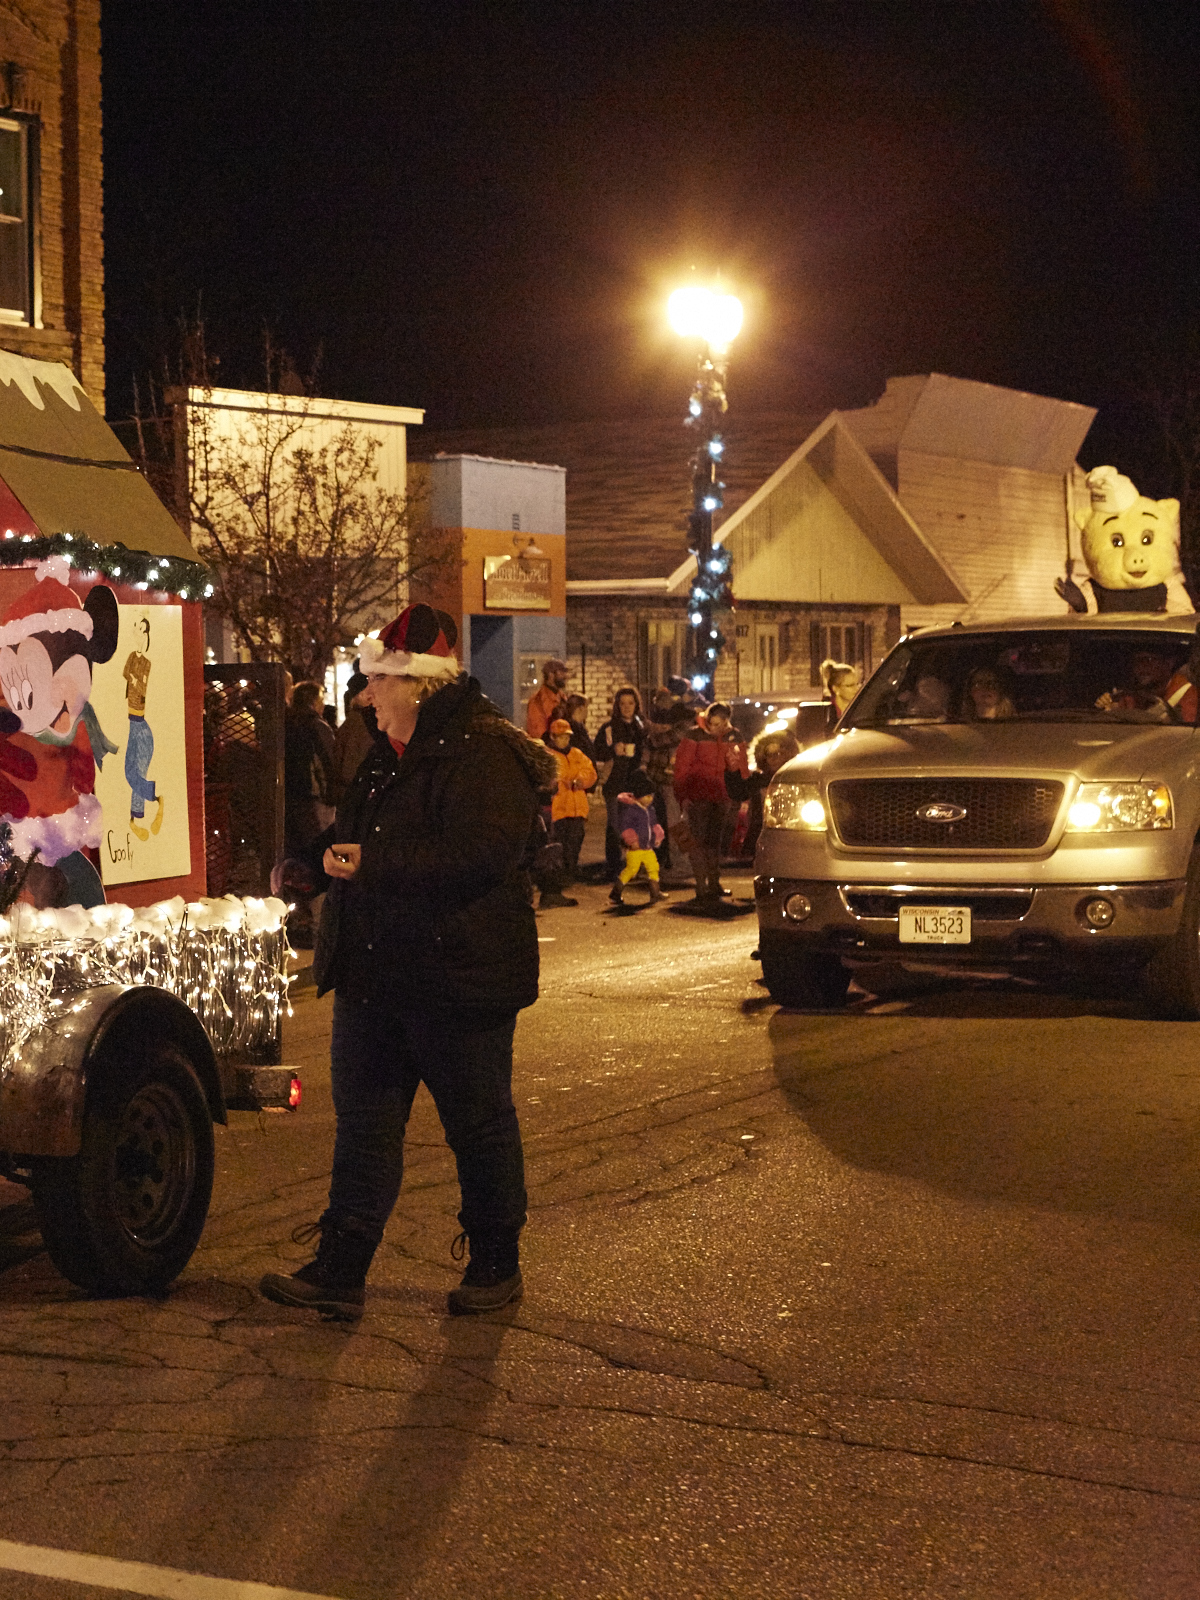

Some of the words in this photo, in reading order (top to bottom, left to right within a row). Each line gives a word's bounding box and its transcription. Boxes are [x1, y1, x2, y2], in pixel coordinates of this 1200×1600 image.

[925, 805, 954, 818] Ford
[107, 829, 134, 869] Goofy
[915, 916, 963, 934] NL3523
